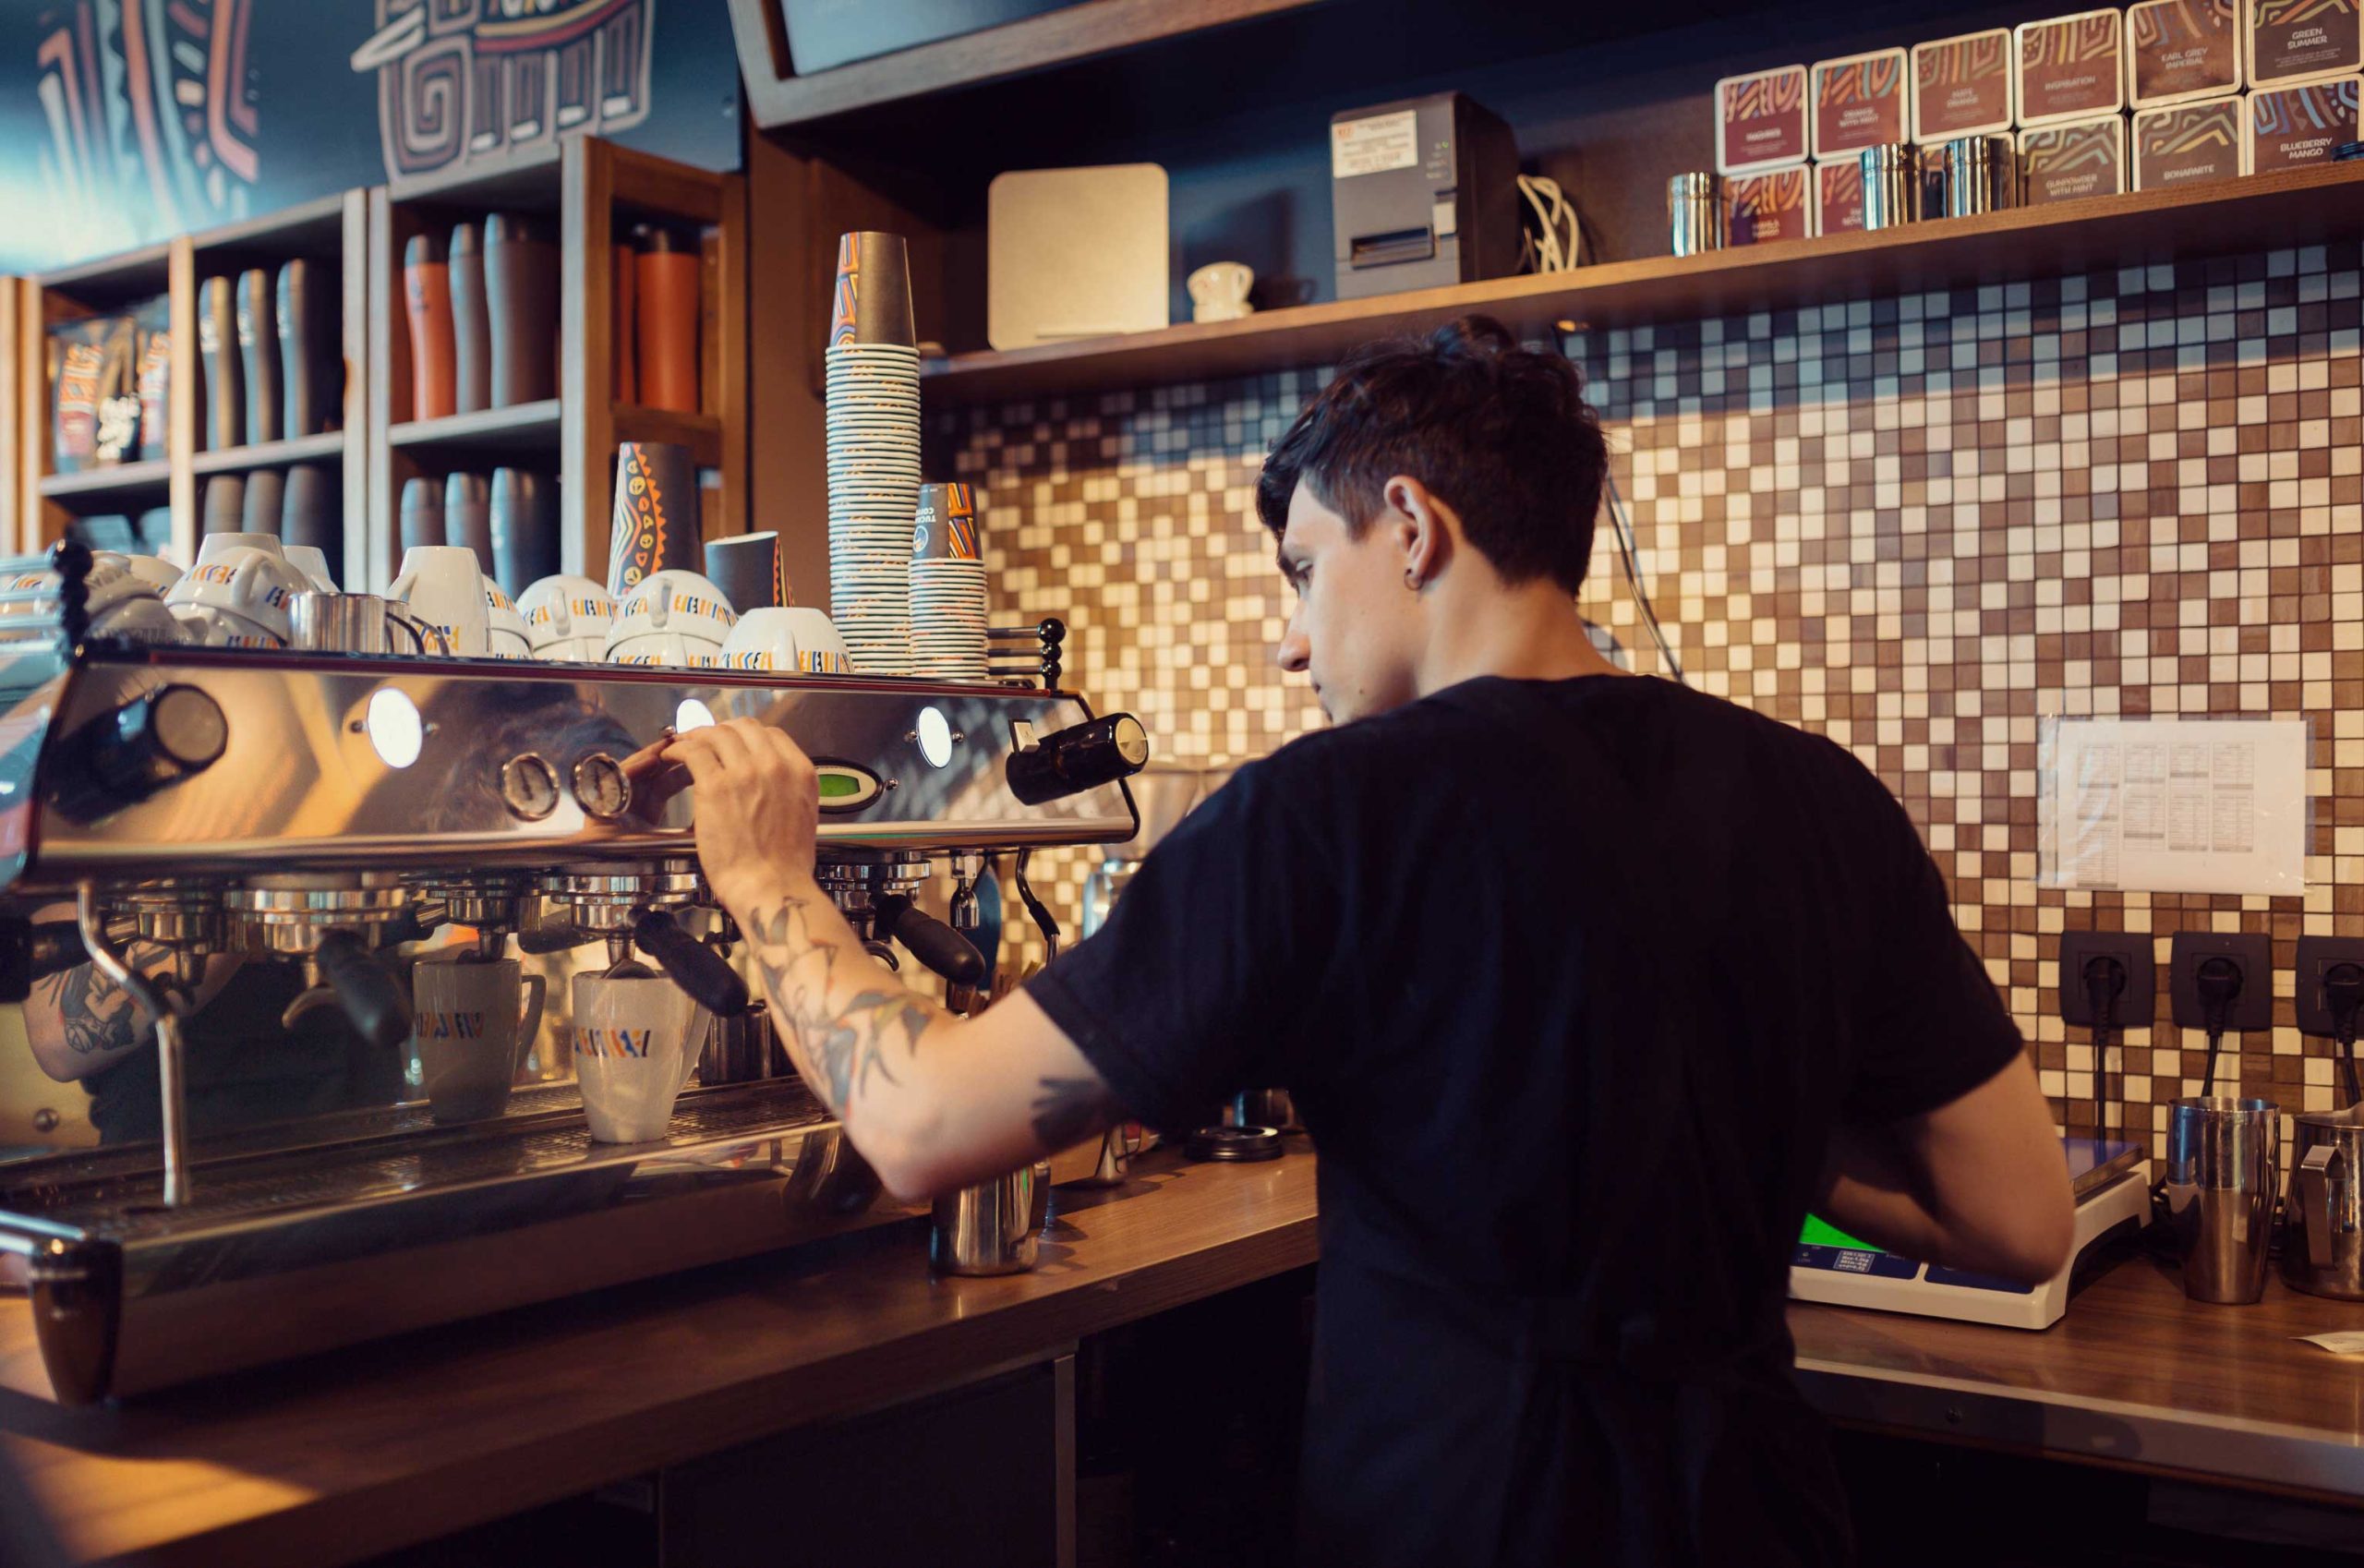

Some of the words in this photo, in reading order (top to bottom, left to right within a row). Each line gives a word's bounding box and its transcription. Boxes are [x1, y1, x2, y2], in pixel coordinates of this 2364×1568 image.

[2293, 28, 2322, 40] GREEN
[2288, 36, 2327, 49] SUMMER
[2280, 138, 2333, 152] BLUEBERRY
[2289, 148, 2324, 159] MANGO
[2164, 164, 2215, 179] BONAPARTE
